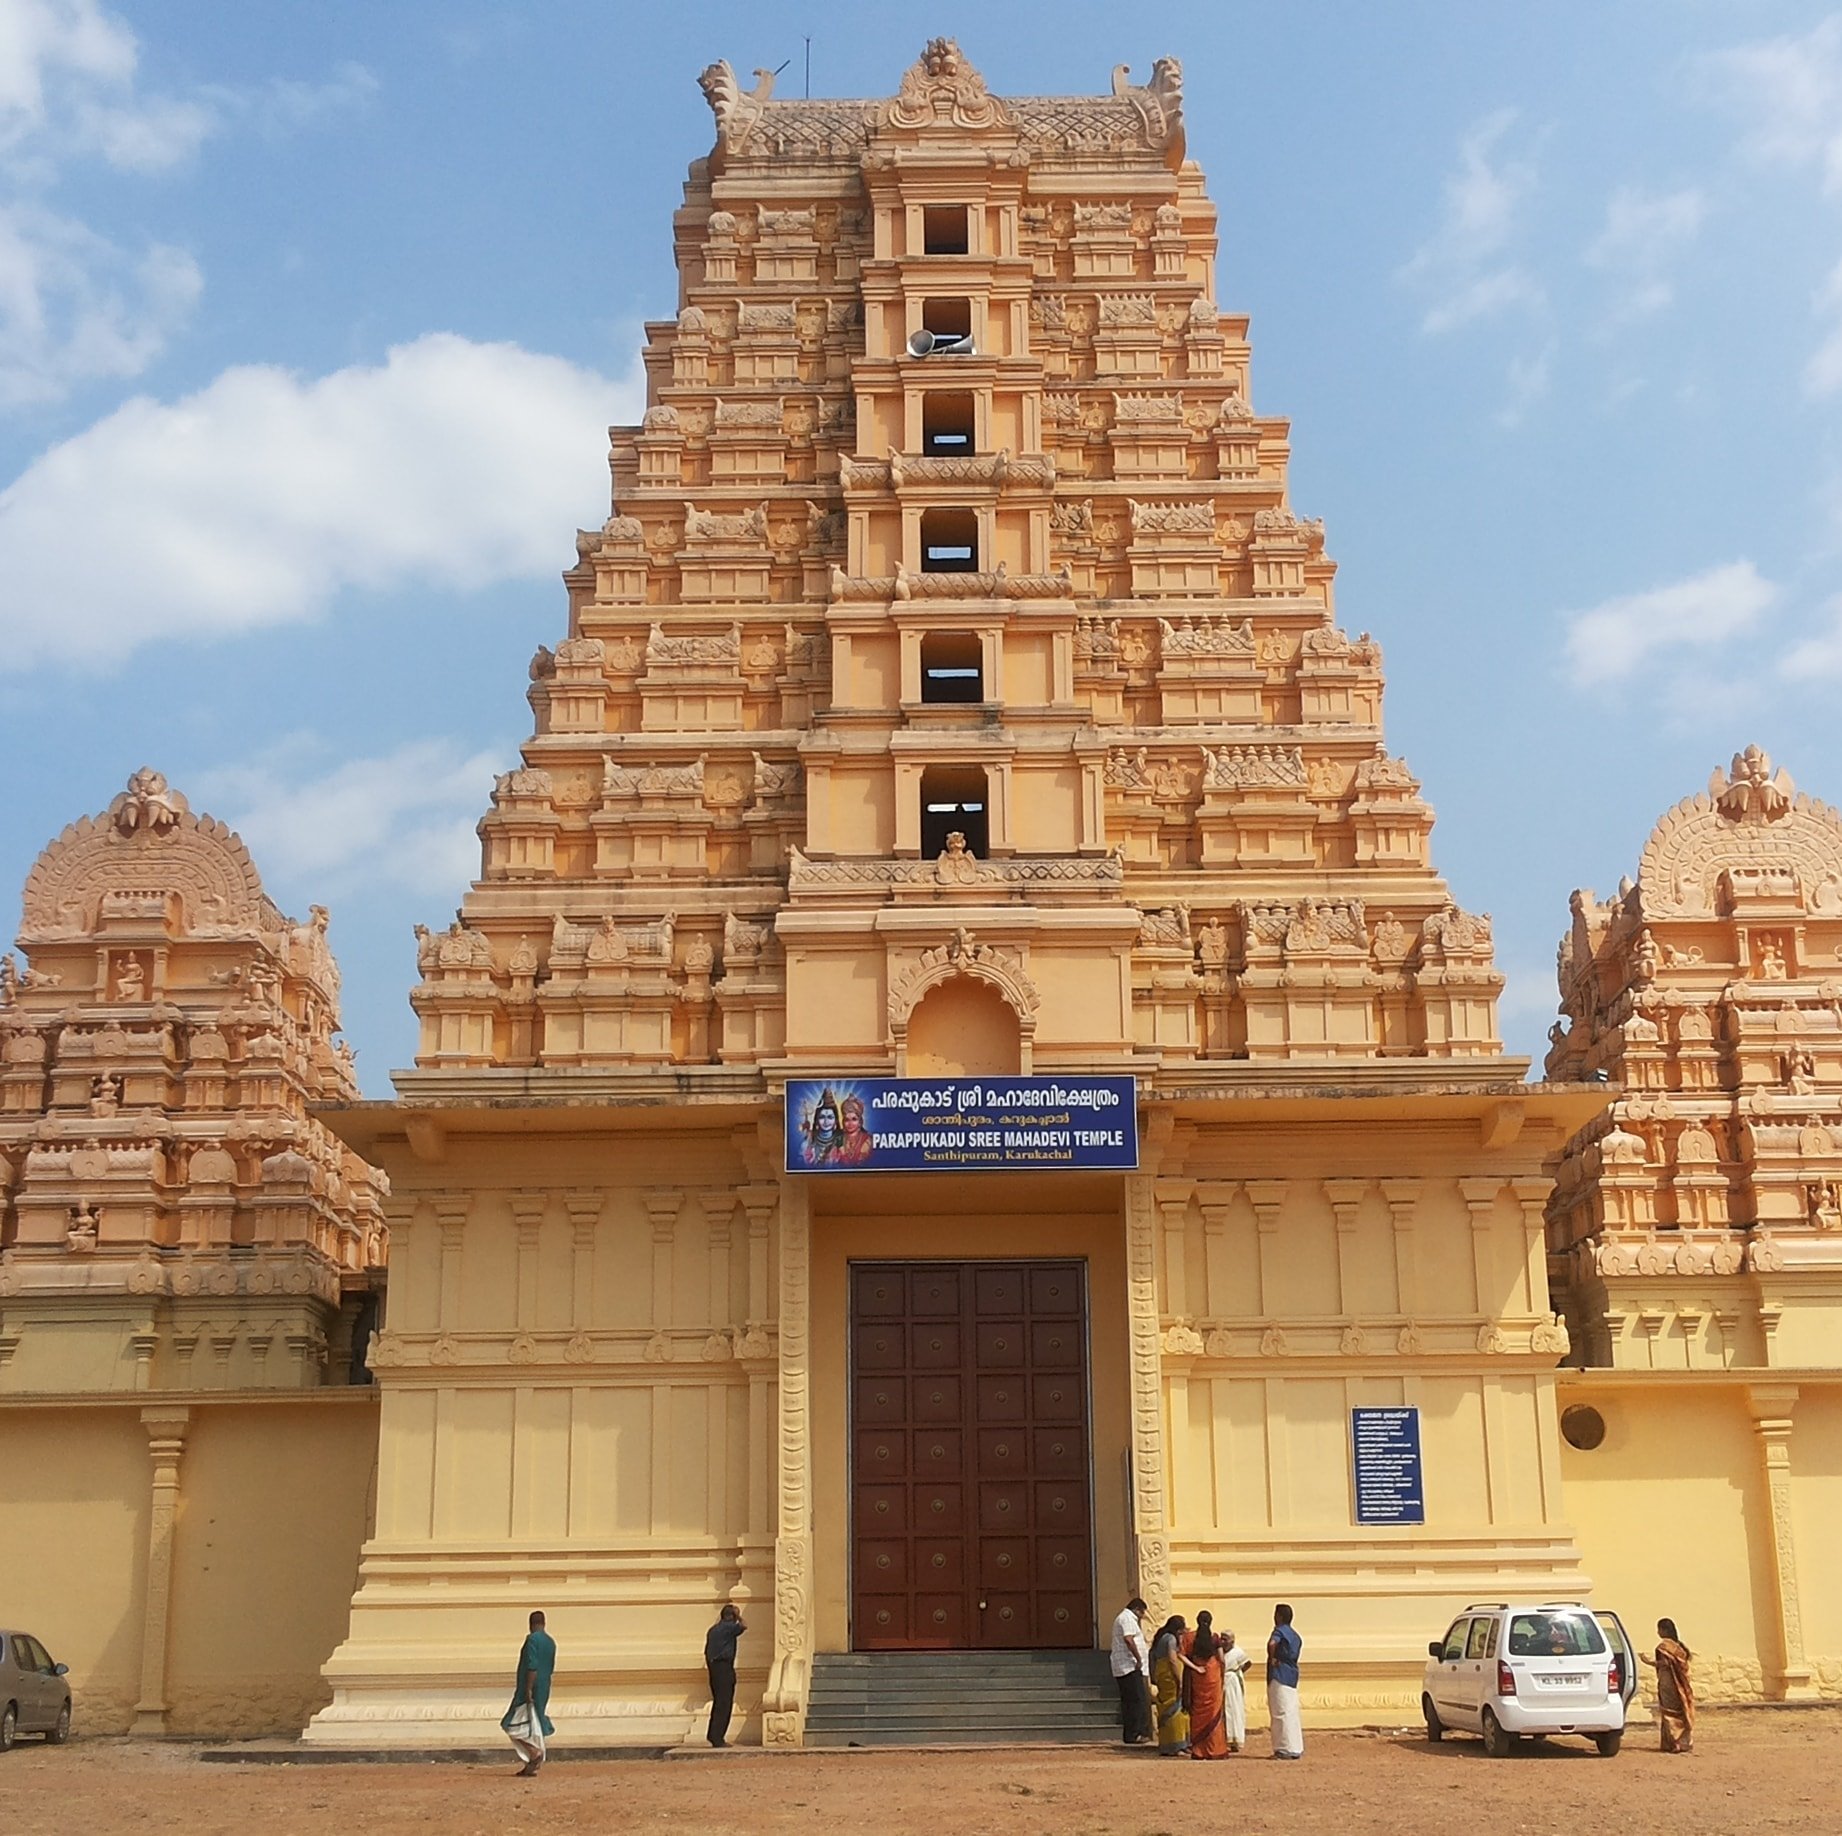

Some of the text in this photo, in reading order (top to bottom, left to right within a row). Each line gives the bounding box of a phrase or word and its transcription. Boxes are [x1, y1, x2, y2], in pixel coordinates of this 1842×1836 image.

[872, 1085, 955, 1112] പരപ്പുകാട്
[958, 1084, 982, 1112] ശ്രീ
[872, 1131, 1123, 1148] PARAPPUKADU SREE MAHADEVI TEMPLE
[924, 1149, 1072, 1163] Santhipuram, Karukachal
